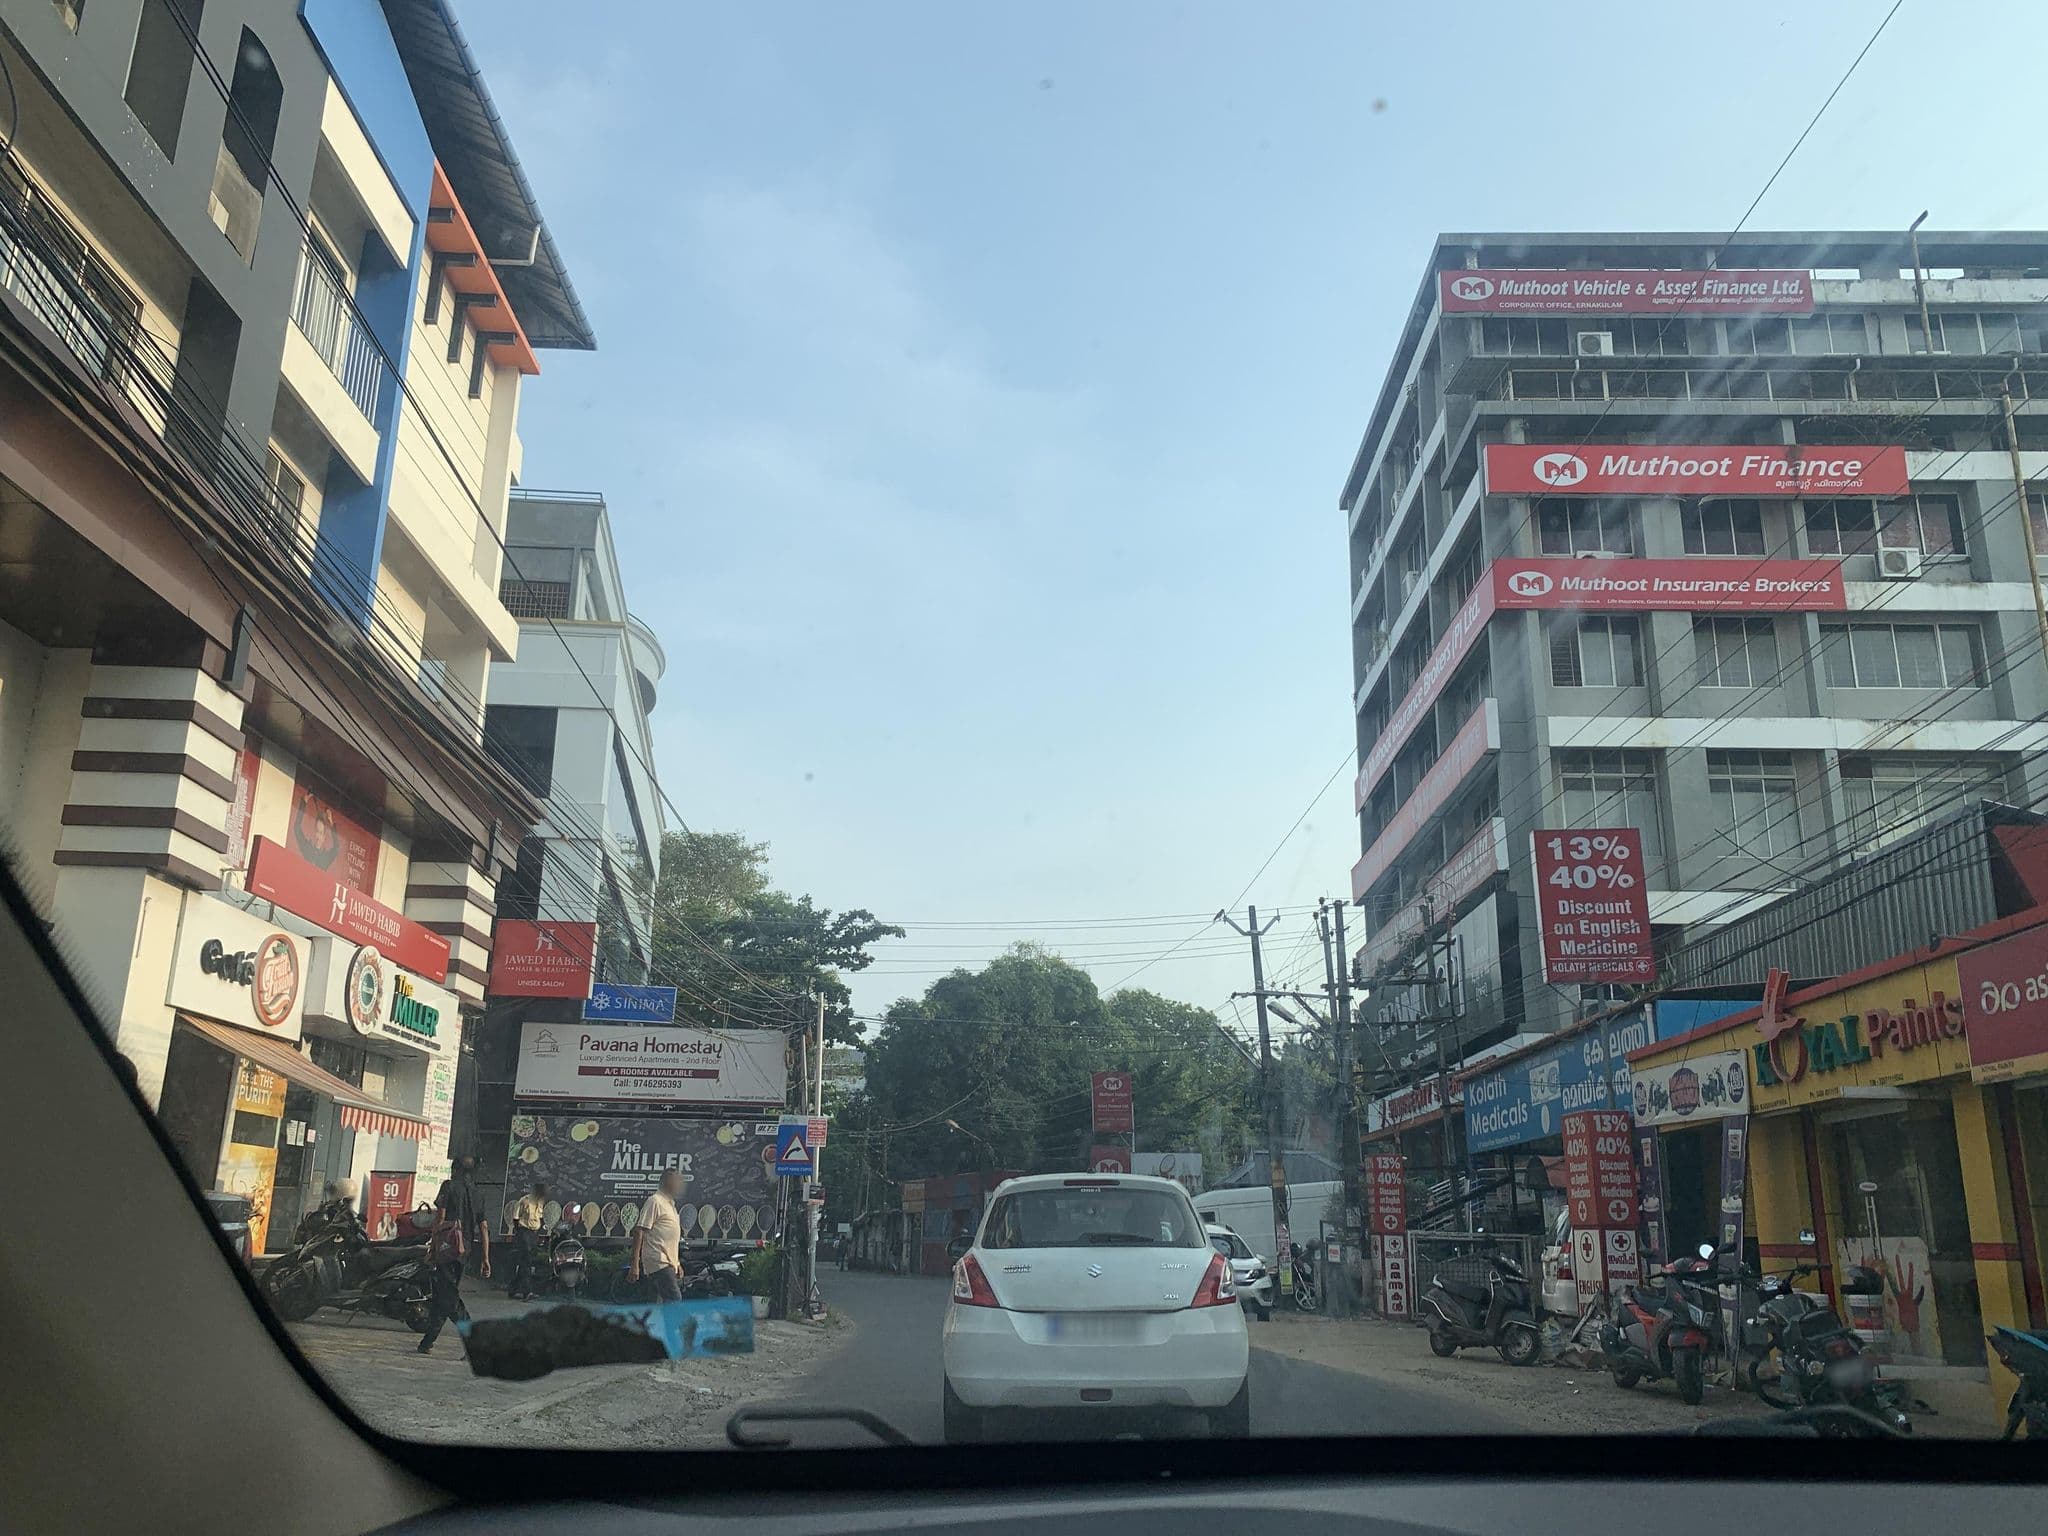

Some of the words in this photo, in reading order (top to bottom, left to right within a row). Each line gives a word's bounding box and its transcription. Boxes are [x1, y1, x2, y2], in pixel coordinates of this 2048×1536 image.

[1499, 279, 1569, 295] Muthoot
[1573, 279, 1631, 295] Vehicle
[1635, 283, 1646, 295] &
[1652, 279, 1698, 295] Asset
[1702, 279, 1767, 295] Finance
[1772, 279, 1803, 295] Ltd.
[1598, 455, 1731, 477] Muthoot
[1740, 455, 1862, 477] Finance
[1560, 576, 1648, 591] Muthoot
[1653, 577, 1750, 592] Insurance
[1755, 577, 1832, 592] Brokers
[1547, 835, 1630, 860] 13%
[1549, 864, 1635, 889] 40%
[349, 897, 377, 924] JAWED
[377, 911, 401, 937] HABIB
[1558, 900, 1632, 915] Discount
[1554, 922, 1574, 935] on
[1579, 919, 1641, 938] English
[1560, 939, 1638, 955] Medicine
[504, 955, 544, 965] JAWED
[1552, 962, 1586, 973] KOLATH
[394, 975, 414, 997] The
[518, 979, 541, 987] UNISEX
[542, 980, 565, 988] SALON
[2025, 974, 2048, 1001] as
[389, 992, 440, 1038] MILLER
[1864, 991, 1964, 1058] Paints
[580, 1034, 639, 1052] Pavana
[643, 1036, 722, 1058] Homestay
[580, 1054, 605, 1062] Luxury
[638, 1055, 679, 1064] Apartments
[241, 1071, 257, 1085] FEEL
[259, 1075, 274, 1089] THE
[621, 1068, 649, 1076] ROOMS
[651, 1069, 694, 1077] AVAILABLE
[613, 1079, 632, 1087] Call:
[1468, 1072, 1507, 1107] Kolath
[238, 1085, 272, 1106] PURITY
[1470, 1101, 1528, 1137] Medicals
[1564, 1116, 1586, 1136] 13%
[1593, 1114, 1629, 1133] 13%
[613, 1140, 641, 1152] The
[1566, 1138, 1589, 1158] 40%
[1596, 1136, 1631, 1155] 40%
[611, 1152, 693, 1171] MILLER
[1377, 1157, 1400, 1169] 13%
[1600, 1159, 1630, 1171] Discount
[1377, 1172, 1401, 1184] 40%
[383, 1182, 399, 1197] 90
